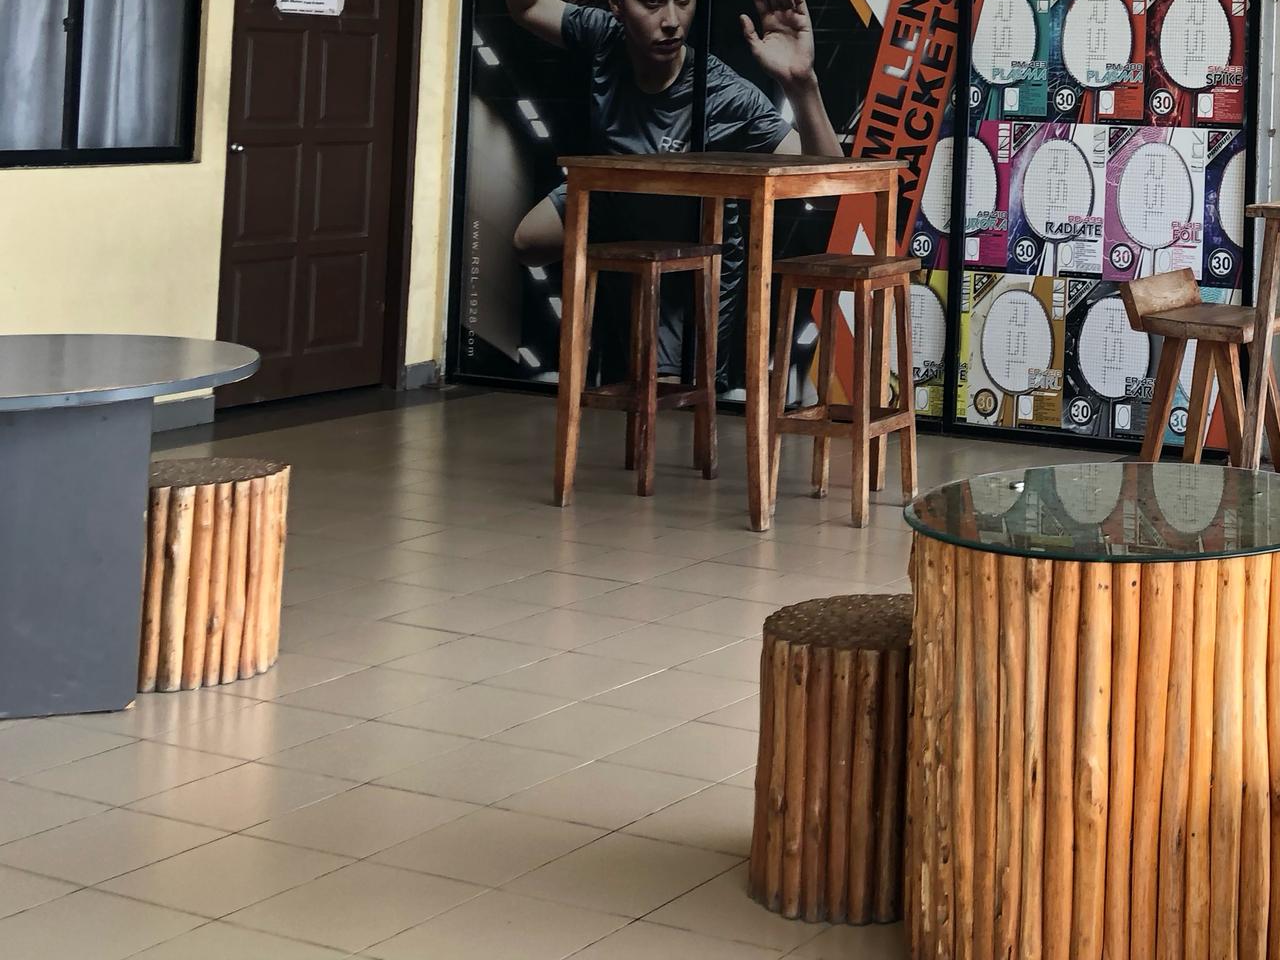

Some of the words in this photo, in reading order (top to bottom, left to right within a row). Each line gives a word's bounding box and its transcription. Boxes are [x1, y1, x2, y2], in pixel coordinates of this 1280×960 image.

[1205, 73, 1242, 86] SPIKE
[1057, 94, 1074, 107] 30
[1153, 96, 1171, 110] 30
[1045, 221, 1102, 236] RADIATE
[1172, 229, 1201, 243] FOIL
[913, 239, 930, 253] 30
[1017, 243, 1035, 257] 30
[1113, 250, 1130, 264] 30
[1212, 256, 1230, 270] 30
[1125, 384, 1154, 398] EAR
[976, 396, 994, 410] 30
[1071, 403, 1089, 418] 30
